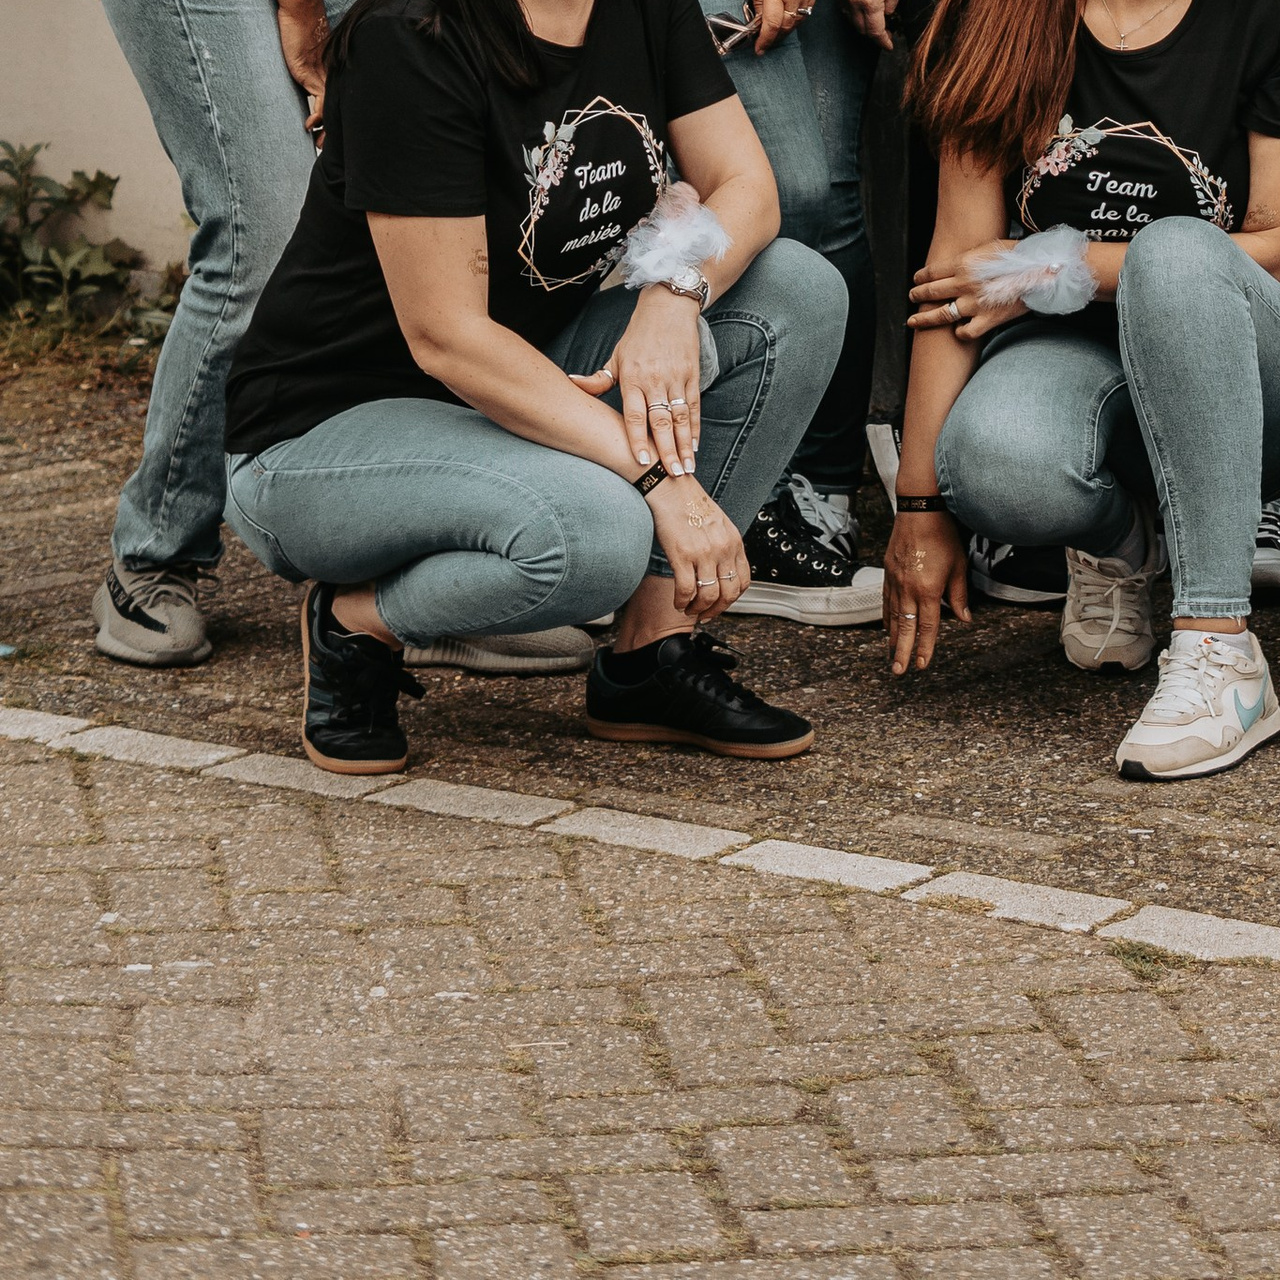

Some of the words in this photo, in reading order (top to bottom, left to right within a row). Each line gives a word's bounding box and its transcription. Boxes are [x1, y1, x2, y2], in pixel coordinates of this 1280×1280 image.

[574, 159, 626, 190] Team
[1086, 171, 1158, 198] Team
[579, 198, 602, 223] de
[599, 190, 622, 215] la
[1090, 202, 1122, 220] de
[1126, 204, 1154, 223] la
[560, 221, 623, 254] mariée
[1084, 228, 1139, 238] mari
